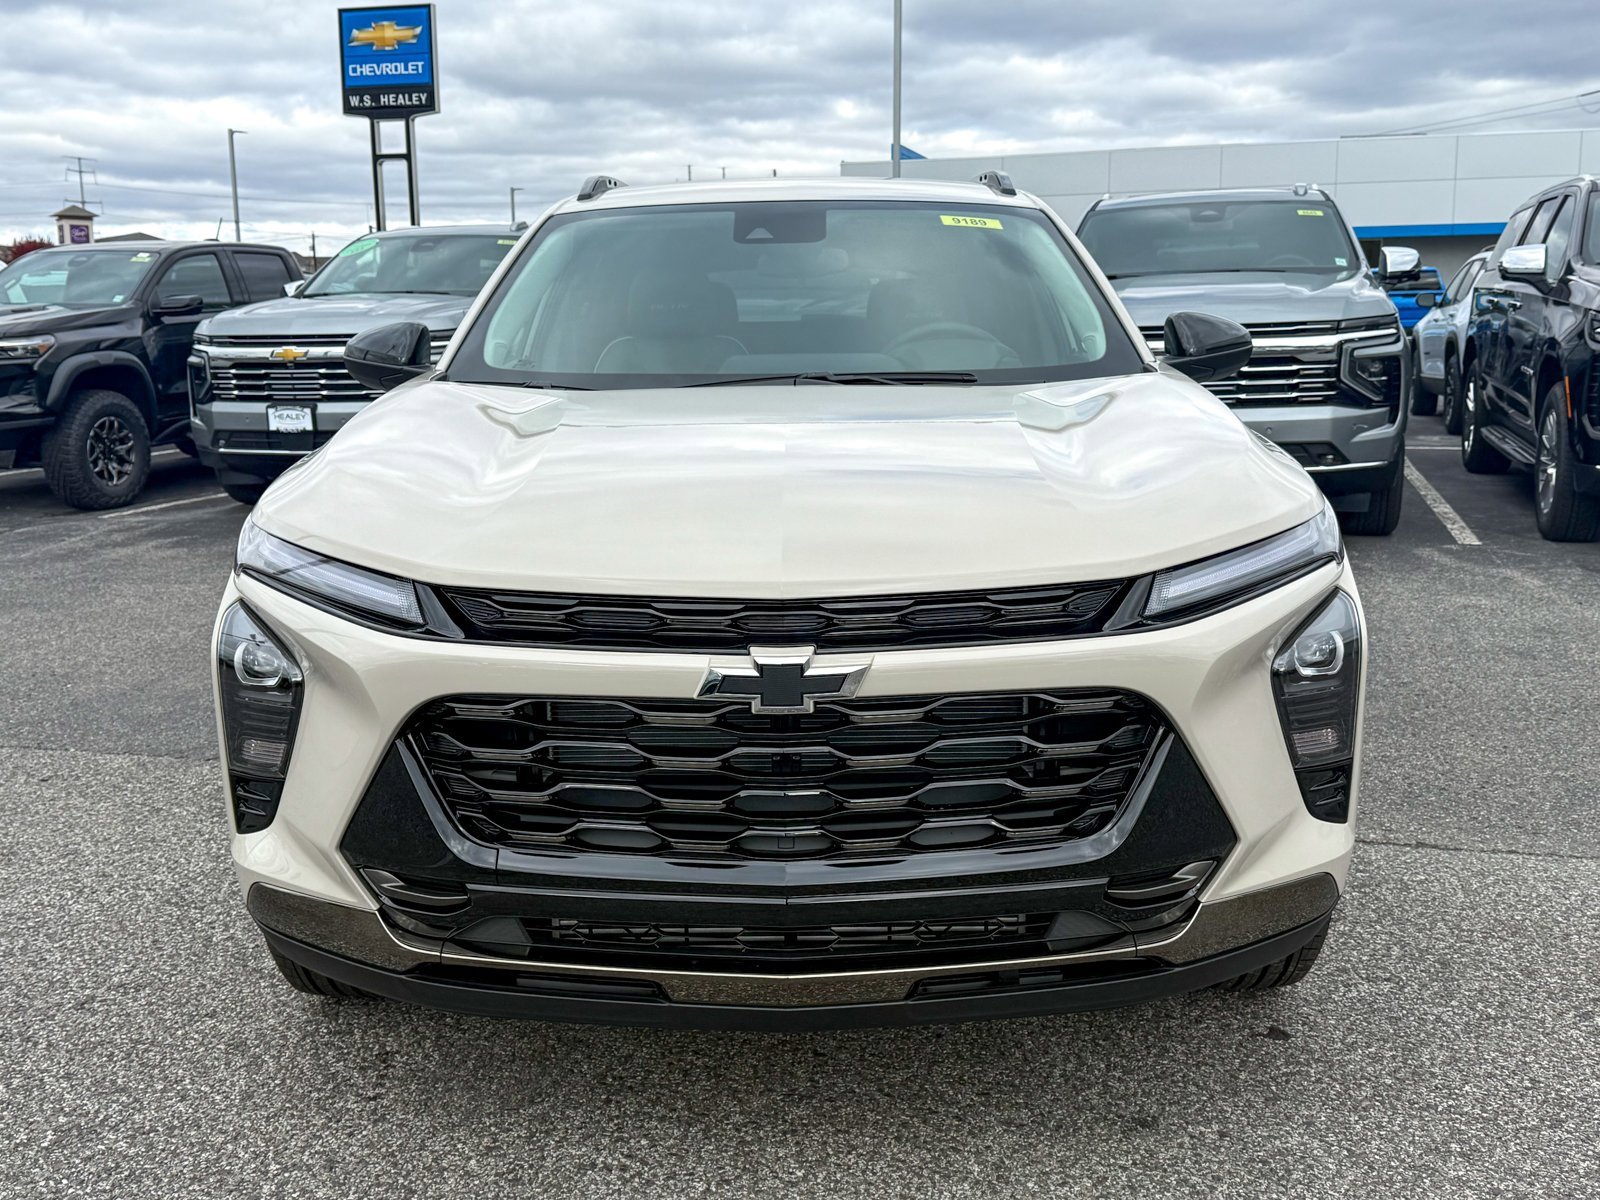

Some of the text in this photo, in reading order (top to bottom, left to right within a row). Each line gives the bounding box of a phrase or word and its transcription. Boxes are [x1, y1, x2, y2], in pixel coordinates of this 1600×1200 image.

[349, 61, 424, 76] CHEVROLET
[349, 93, 427, 107] W.S. HEALEY
[951, 217, 987, 226] 9189
[274, 413, 306, 421] HEALEY
